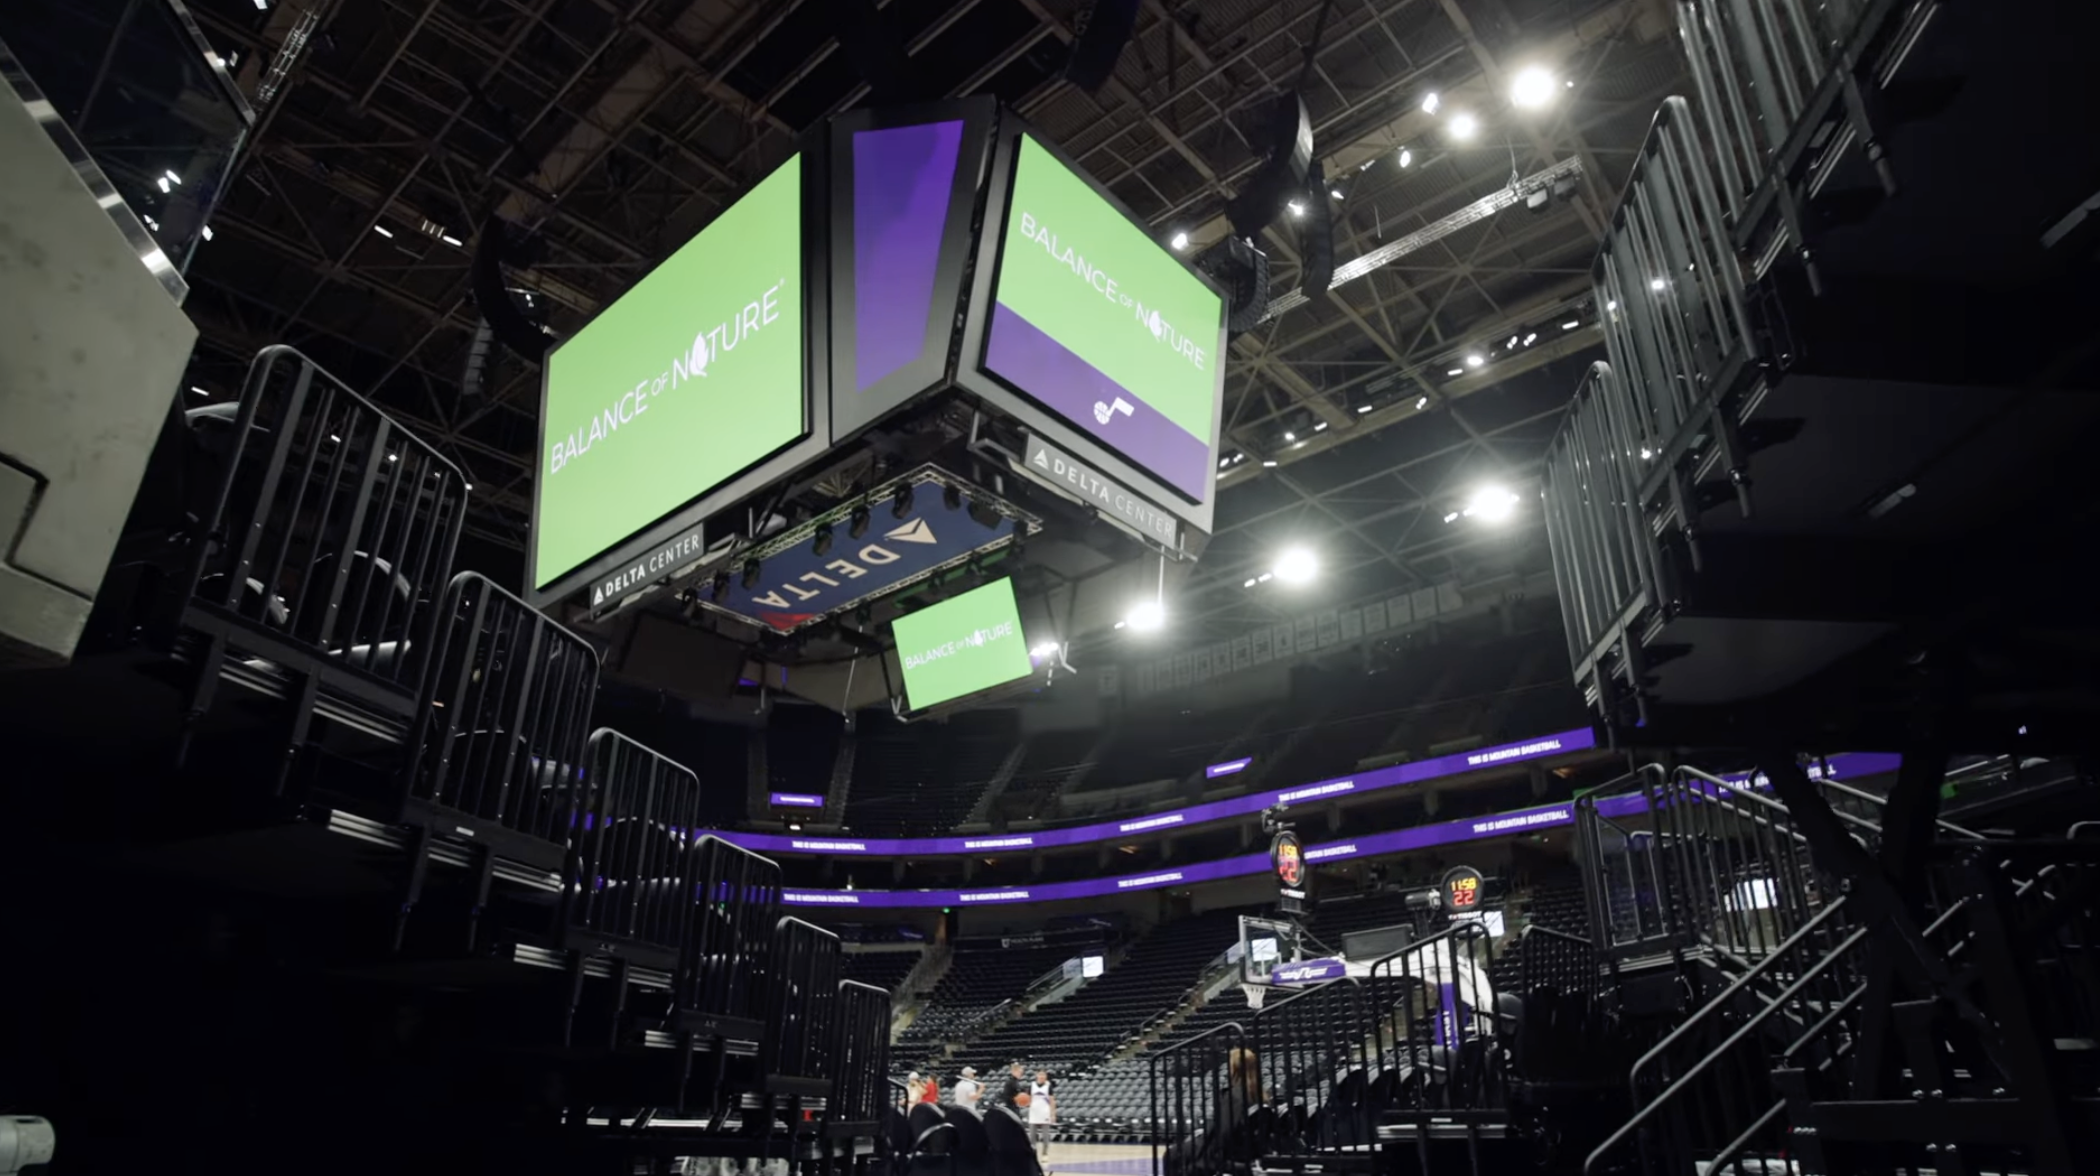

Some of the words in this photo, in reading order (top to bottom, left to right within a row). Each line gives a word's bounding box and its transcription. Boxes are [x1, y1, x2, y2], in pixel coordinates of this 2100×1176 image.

[1020, 211, 1118, 304] BALANCE
[1119, 293, 1134, 309] OF
[550, 379, 649, 475] BALANCE
[651, 371, 669, 397] OF
[1053, 458, 1110, 503] DELTA
[1114, 494, 1173, 539] CENTER
[605, 563, 646, 597] DELTA
[649, 534, 699, 573] CENTER
[751, 544, 901, 609] DELTA
[905, 641, 956, 670] BALANCE
[1468, 755, 1481, 765] THIS
[1482, 753, 1488, 763] IS
[1489, 747, 1520, 761] MOUNTAIN
[1473, 822, 1487, 833] THIS
[1487, 821, 1494, 831] IS
[1494, 816, 1526, 829] MOUNTAIN
[1453, 890, 1475, 906] 22
